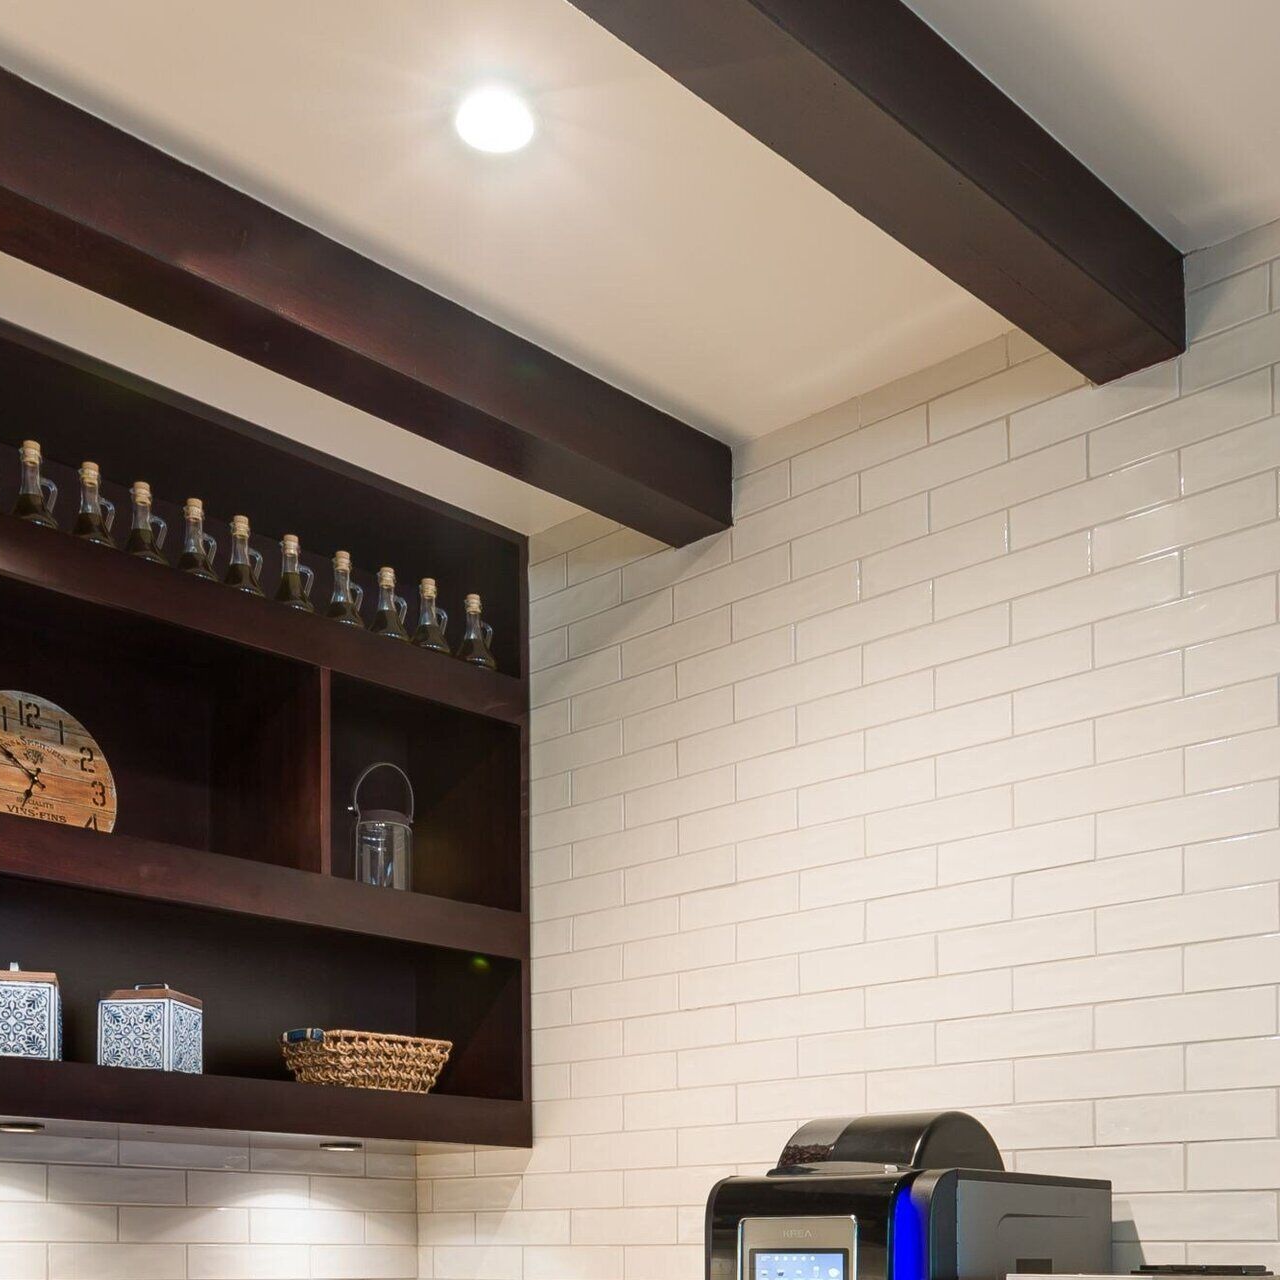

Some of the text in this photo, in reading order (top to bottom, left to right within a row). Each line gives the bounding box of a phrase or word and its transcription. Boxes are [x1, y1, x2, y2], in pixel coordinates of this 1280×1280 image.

[19, 699, 42, 730] 12
[58, 719, 65, 746] 1
[79, 746, 95, 773] 2
[91, 780, 106, 807] 3
